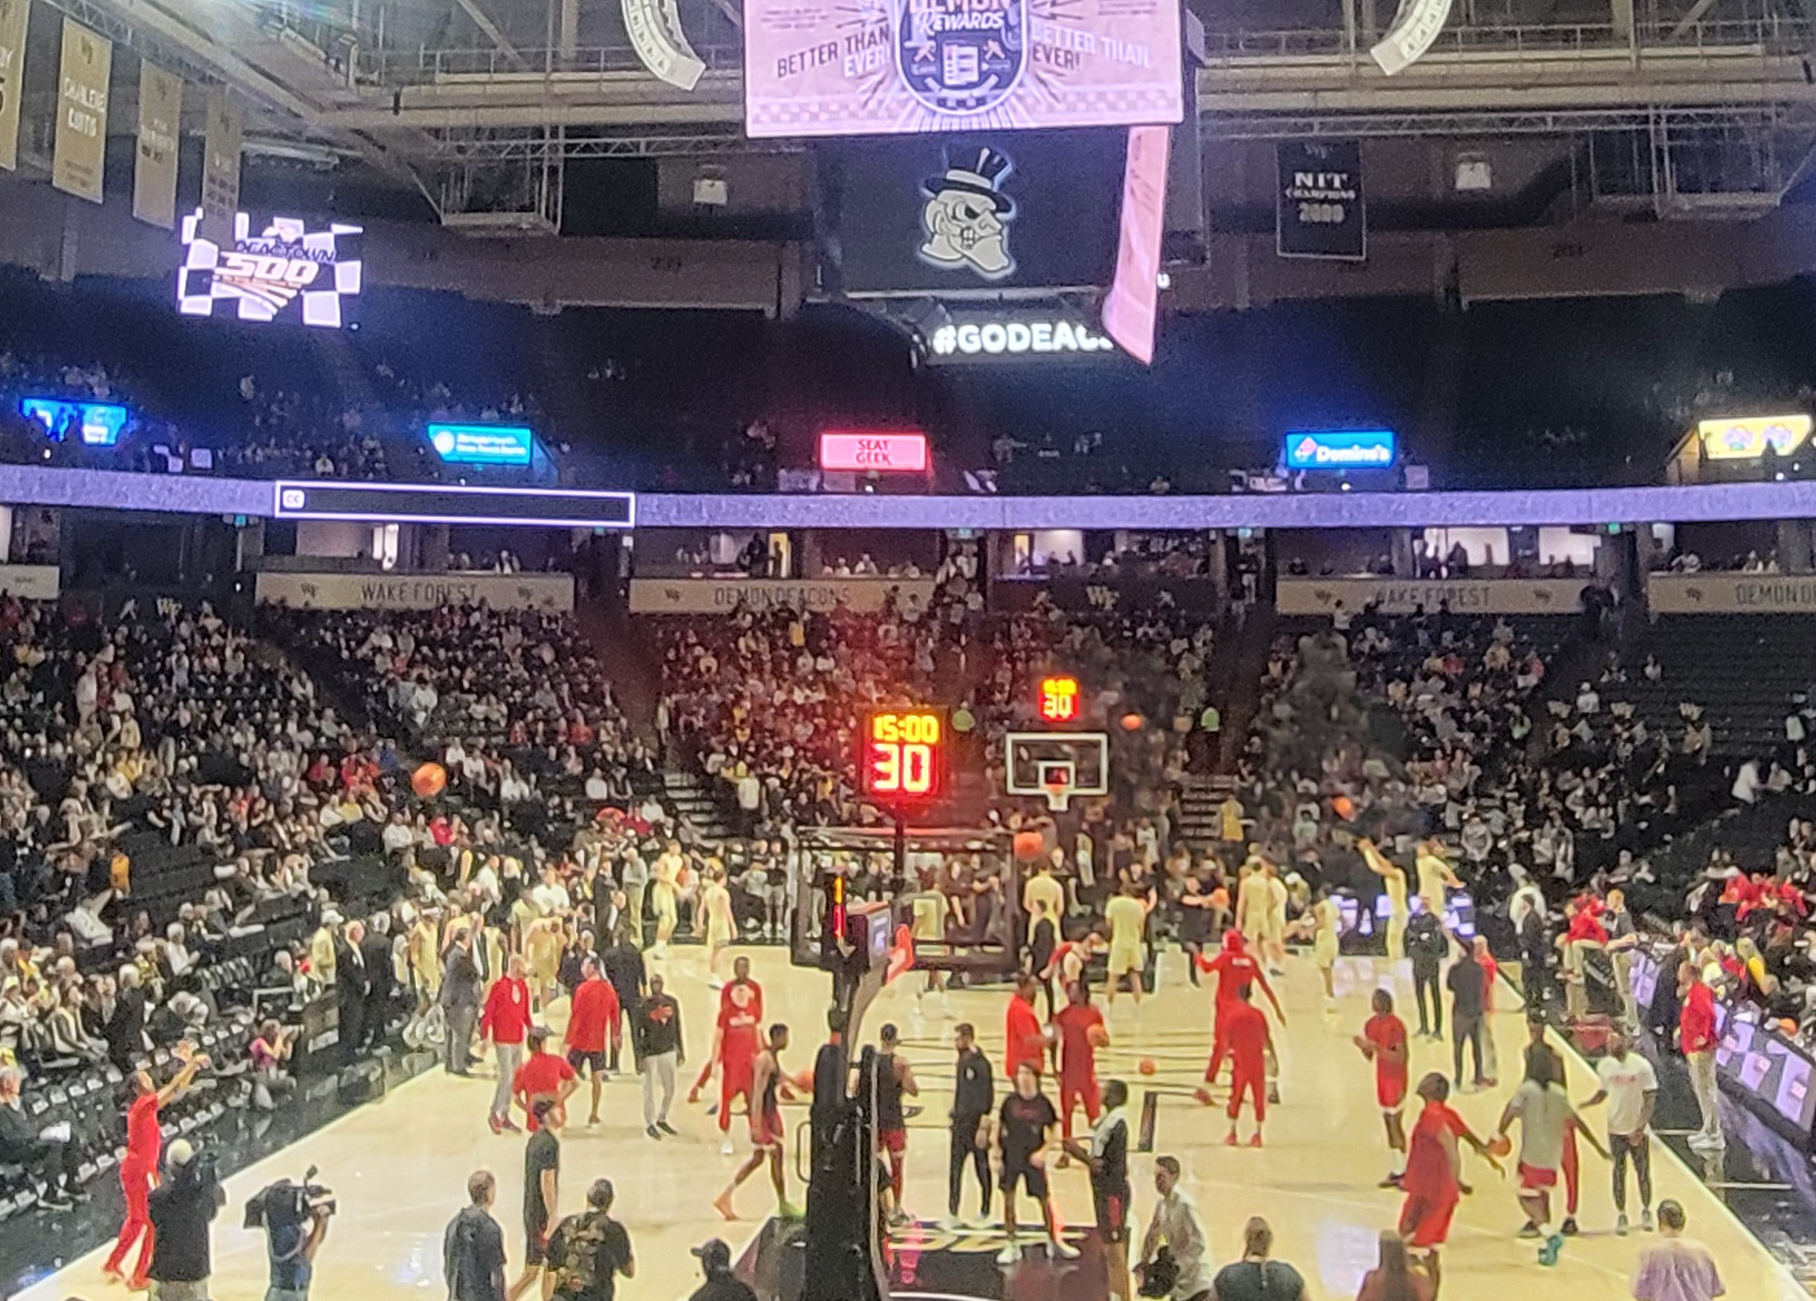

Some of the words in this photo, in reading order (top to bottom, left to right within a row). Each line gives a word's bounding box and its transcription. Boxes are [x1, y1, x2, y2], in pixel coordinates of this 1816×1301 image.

[919, 9, 1005, 36] REWARDS
[777, 41, 839, 78] BETTER
[844, 23, 890, 55] THAN
[1031, 19, 1096, 54] BETTER
[1101, 36, 1151, 68] THAN
[1032, 43, 1081, 71] EVER!
[1294, 172, 1348, 188] NIT
[213, 250, 319, 284] 500
[932, 320, 1114, 355] #GODEAC
[857, 439, 889, 451] SEAT
[1316, 444, 1391, 462] Domino's
[855, 452, 892, 466] GEEK
[361, 582, 409, 602] WAKE
[413, 582, 477, 605] FOREST
[714, 587, 775, 606] DEMON
[776, 587, 851, 606] DEACONS
[1424, 587, 1490, 606] FOREST
[1736, 583, 1798, 605] DEMON
[1043, 694, 1071, 719] 30
[874, 714, 940, 744] 15:00
[874, 743, 931, 793] 30
